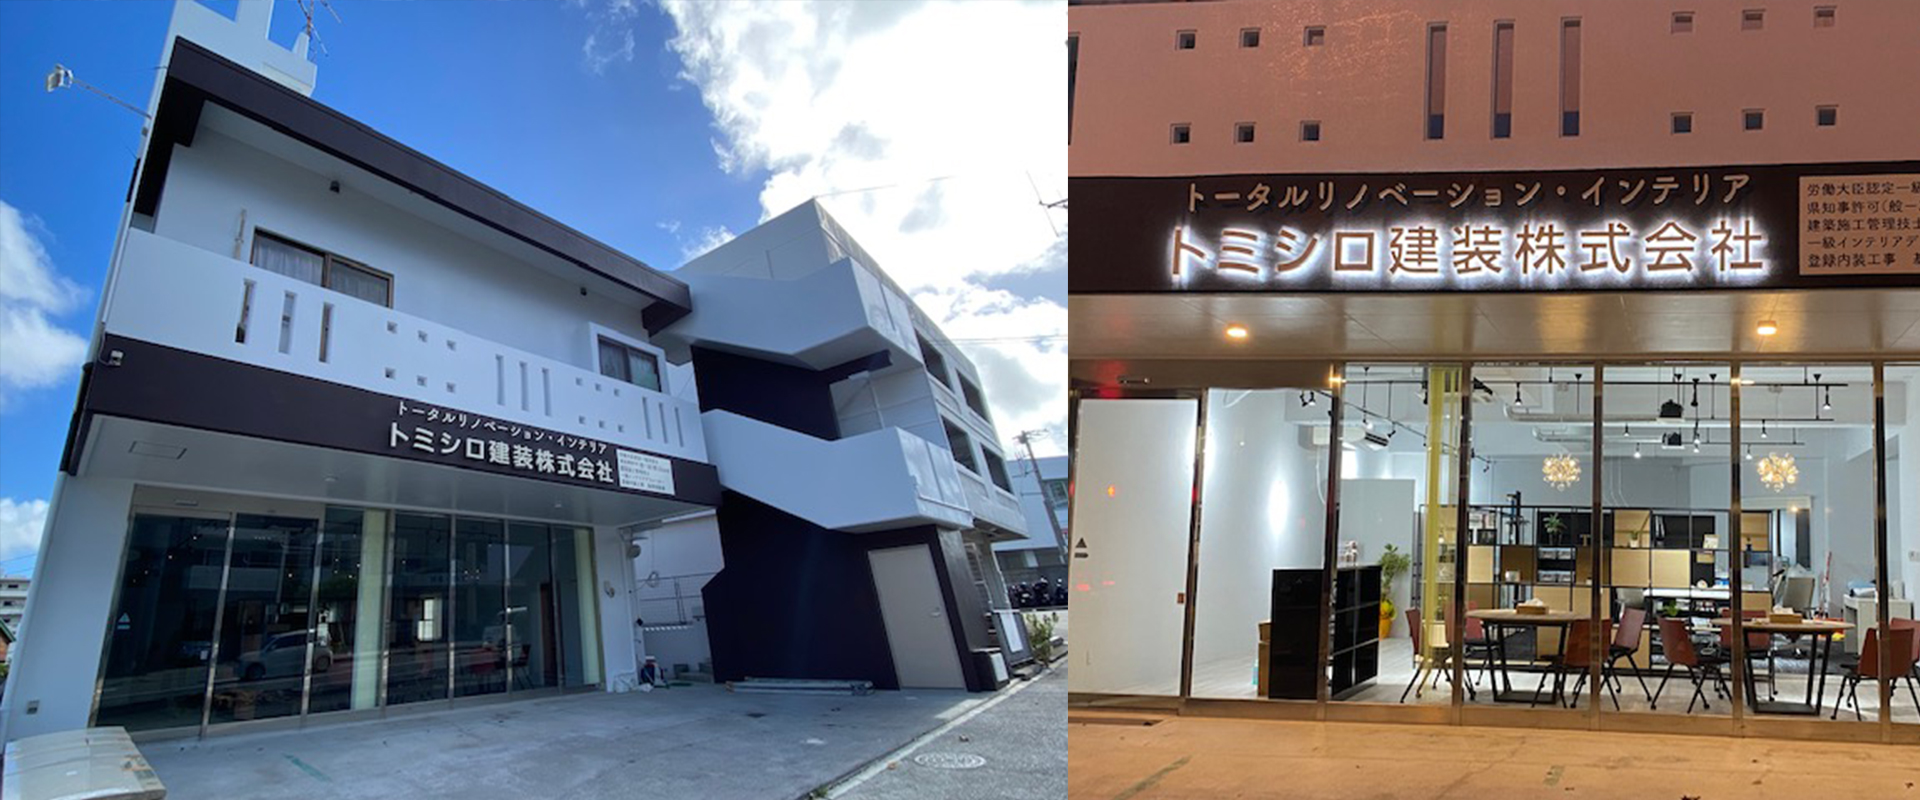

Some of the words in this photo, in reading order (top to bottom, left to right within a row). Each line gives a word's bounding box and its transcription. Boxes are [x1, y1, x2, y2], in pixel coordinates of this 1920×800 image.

[1188, 173, 1751, 212] トータルリノベーション・インテリア
[1171, 218, 1765, 276] トミシロ建装株式会社
[1808, 252, 1897, 268] 登録内装工事
[389, 421, 615, 484] トミシロ建装株式会社
[398, 400, 608, 454] トータルリノベーション・インテリア
